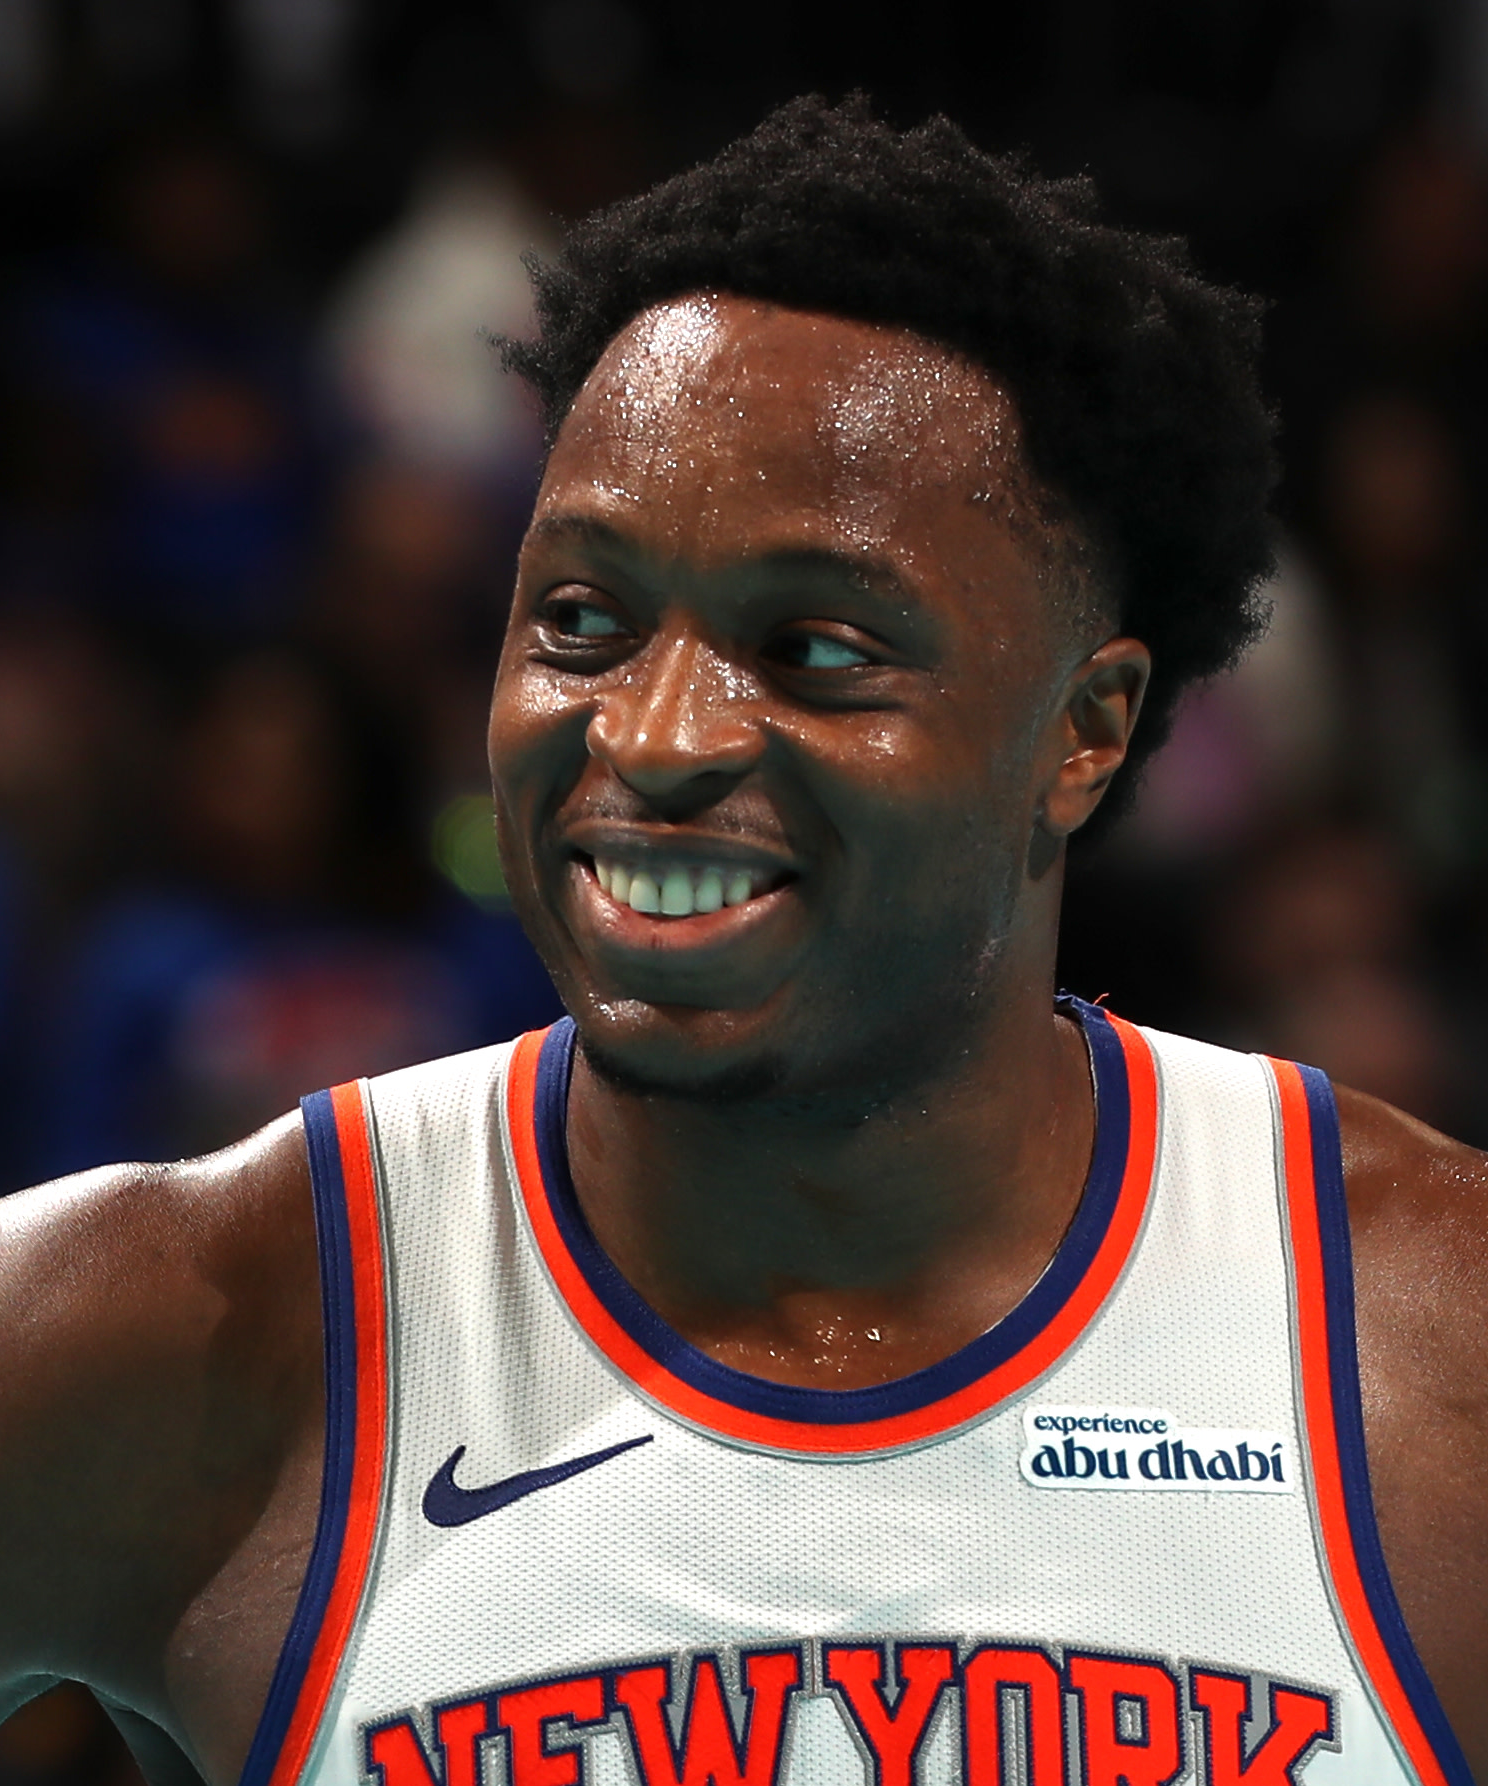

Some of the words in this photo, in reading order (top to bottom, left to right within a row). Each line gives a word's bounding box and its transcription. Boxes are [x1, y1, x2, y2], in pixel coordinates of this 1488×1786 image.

[1033, 1413, 1168, 1436] experience
[1031, 1436, 1130, 1479] abu
[1137, 1439, 1286, 1482] dhabi
